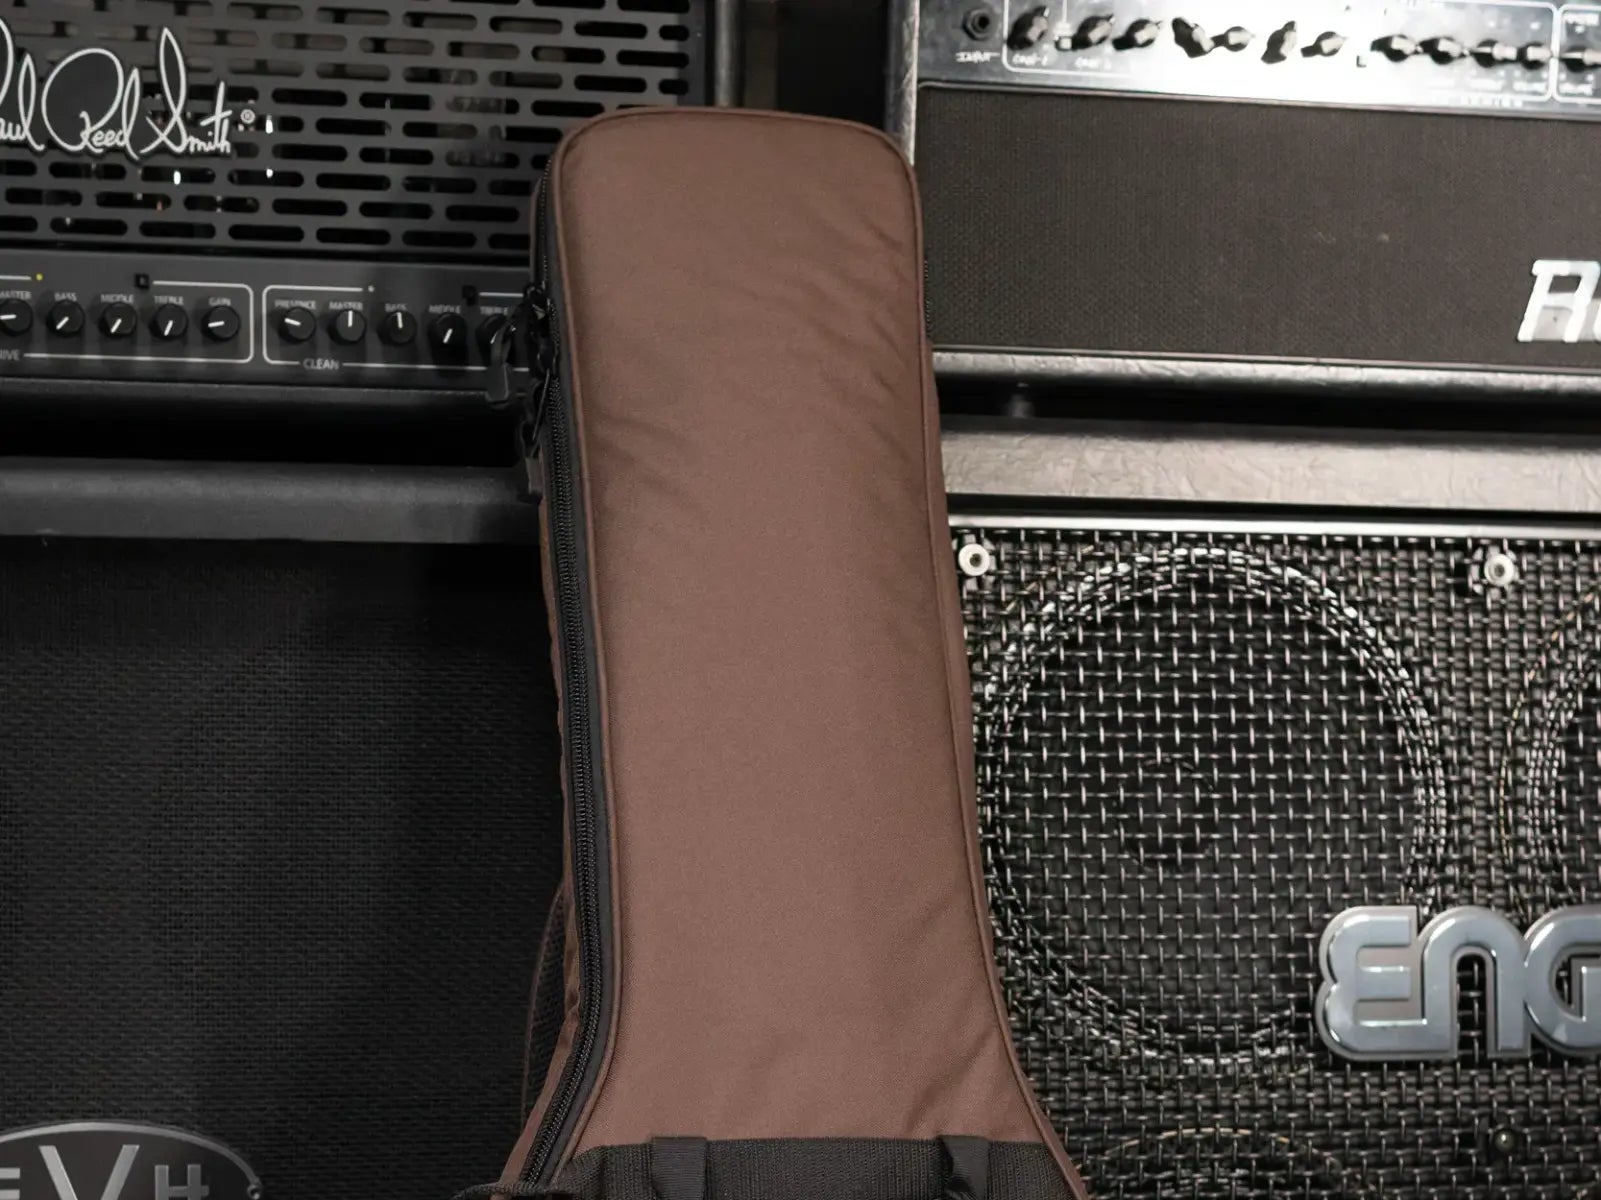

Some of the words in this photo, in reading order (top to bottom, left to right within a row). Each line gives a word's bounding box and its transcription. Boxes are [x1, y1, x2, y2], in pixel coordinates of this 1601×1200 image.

[41, 47, 141, 161] Reed
[139, 26, 233, 154] Smith
[303, 358, 340, 371] CLEAN
